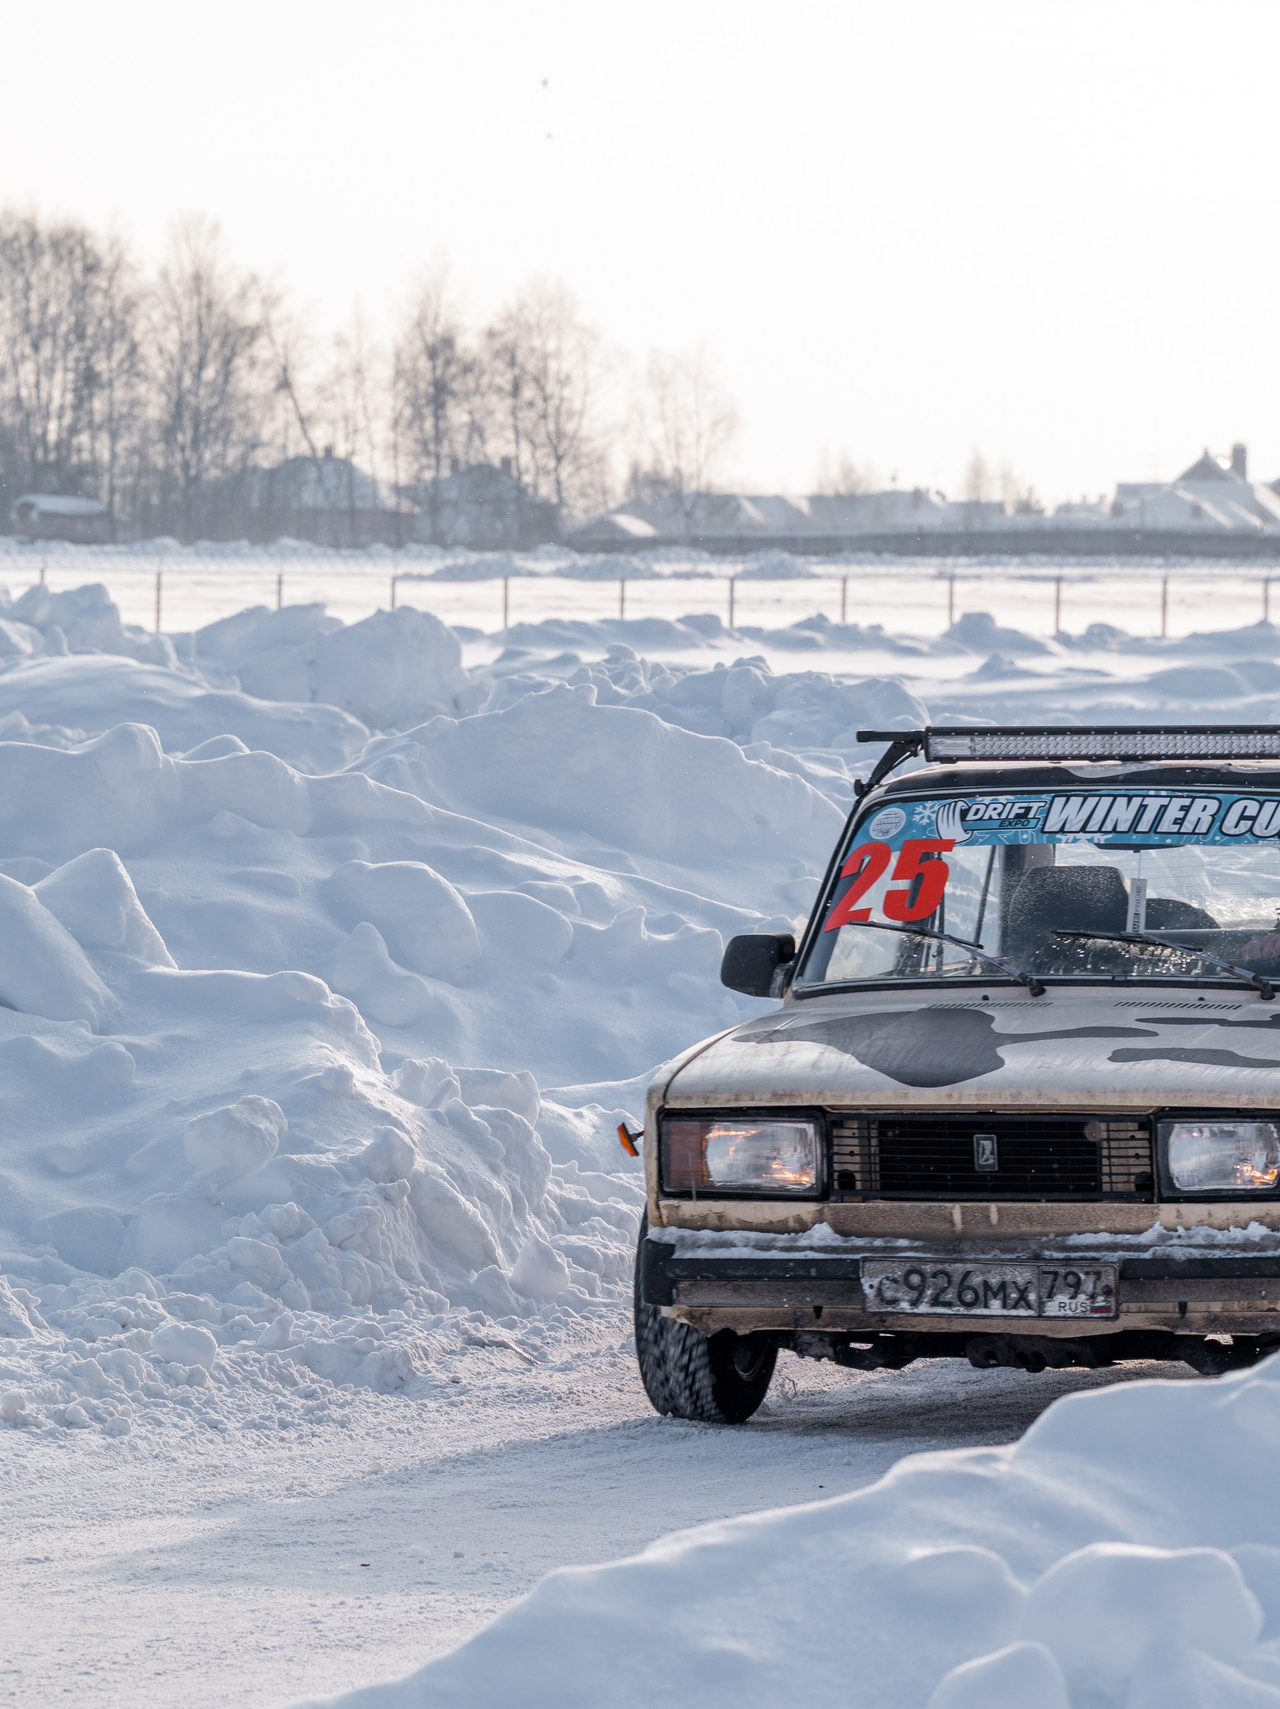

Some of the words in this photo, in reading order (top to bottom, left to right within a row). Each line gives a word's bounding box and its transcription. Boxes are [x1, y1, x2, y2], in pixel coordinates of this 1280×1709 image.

[964, 801, 1047, 821] DRIFT
[998, 819, 1031, 828] EXPO
[1042, 795, 1221, 834] WINTER
[824, 839, 956, 932] 25
[1042, 1270, 1102, 1300] 797
[1057, 1301, 1090, 1313] RUS
